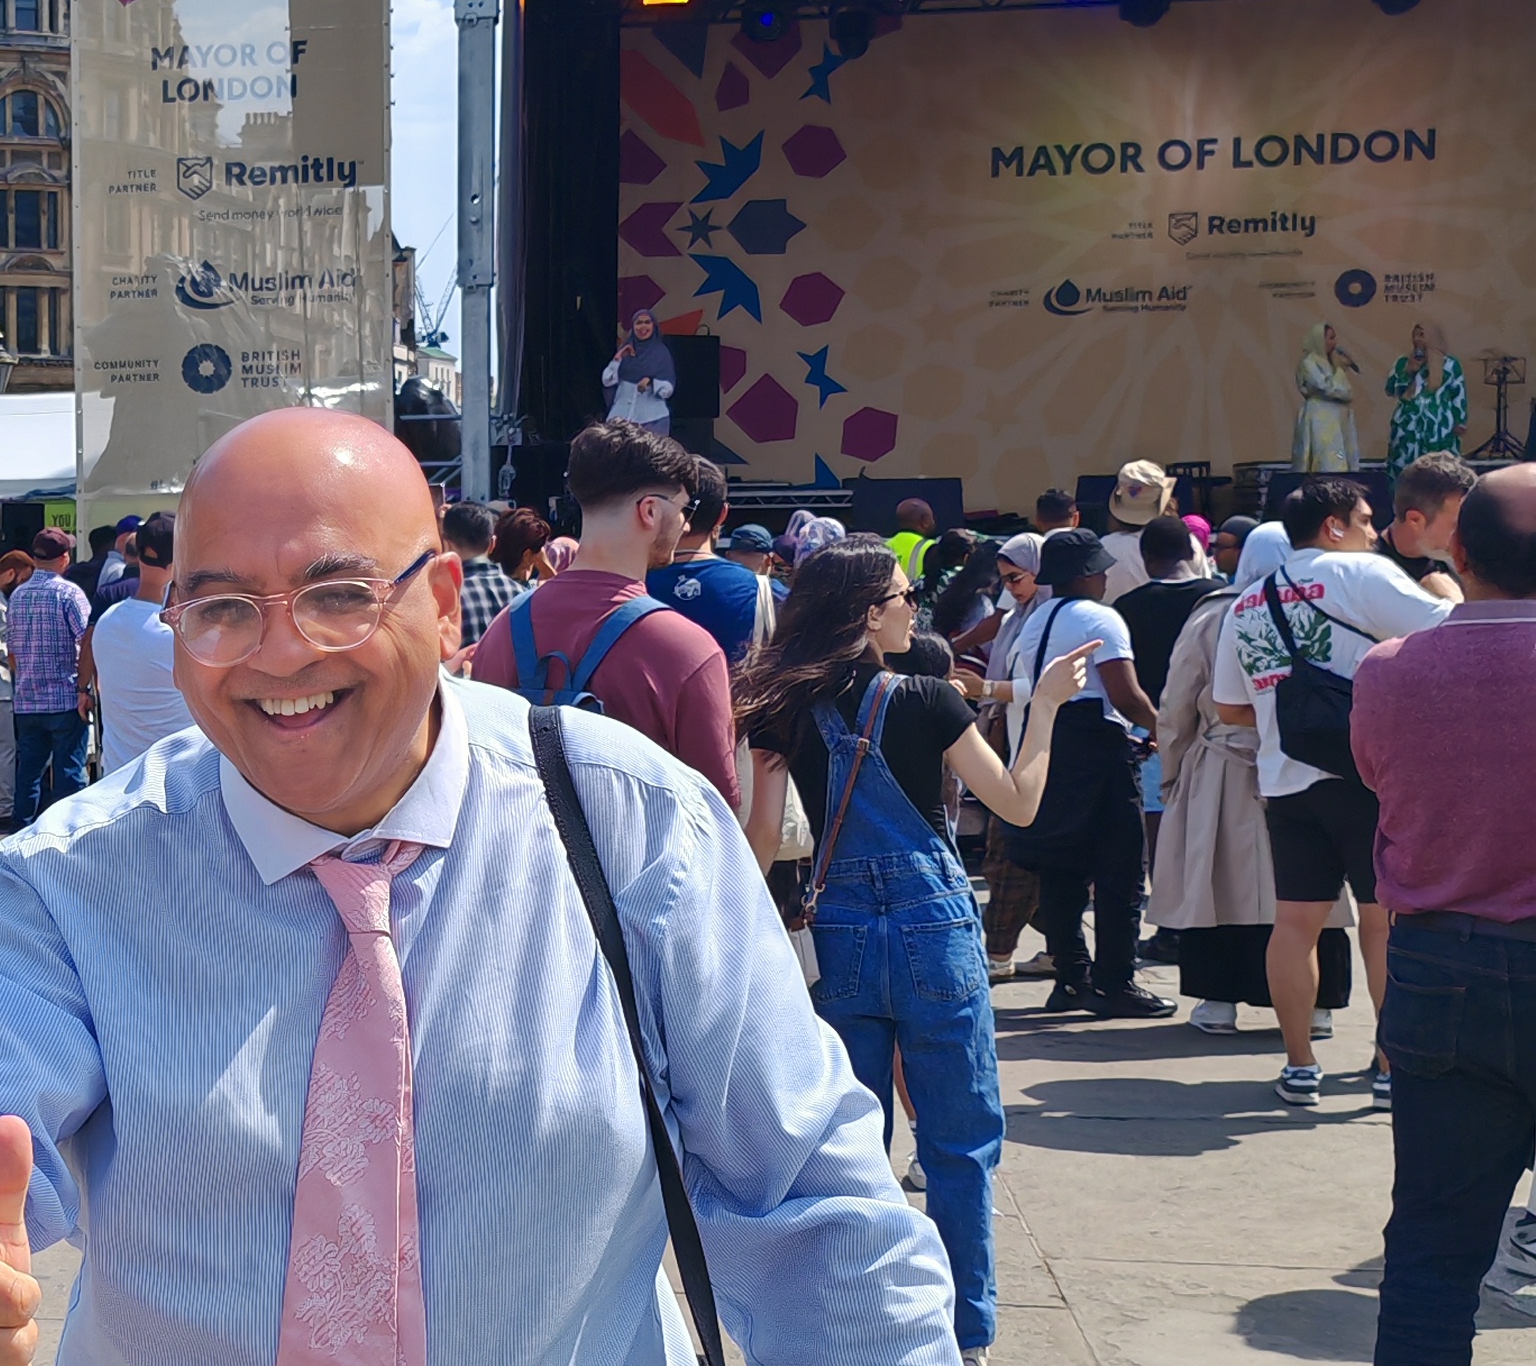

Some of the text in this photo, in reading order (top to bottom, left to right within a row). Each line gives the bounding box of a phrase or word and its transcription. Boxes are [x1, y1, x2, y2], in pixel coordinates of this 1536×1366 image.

[151, 39, 308, 71] MAYOR OF
[162, 74, 298, 104] LONDON
[990, 127, 1438, 179] MAYOR OF LONDON
[127, 169, 157, 179] TITLE
[224, 154, 357, 188] Remitly
[108, 182, 157, 194] PARTNER
[1208, 210, 1316, 237] Remitly
[229, 267, 356, 292] Muslim Aid
[110, 288, 158, 299] PARTNER
[1157, 284, 1188, 302] Aid
[241, 350, 301, 362] BRITISH
[93, 358, 160, 371] COMMUNITY
[241, 362, 302, 375] MUSLIM
[110, 371, 161, 383] PARTNER
[241, 375, 289, 388] TRUST
[51, 514, 72, 528] YOU
